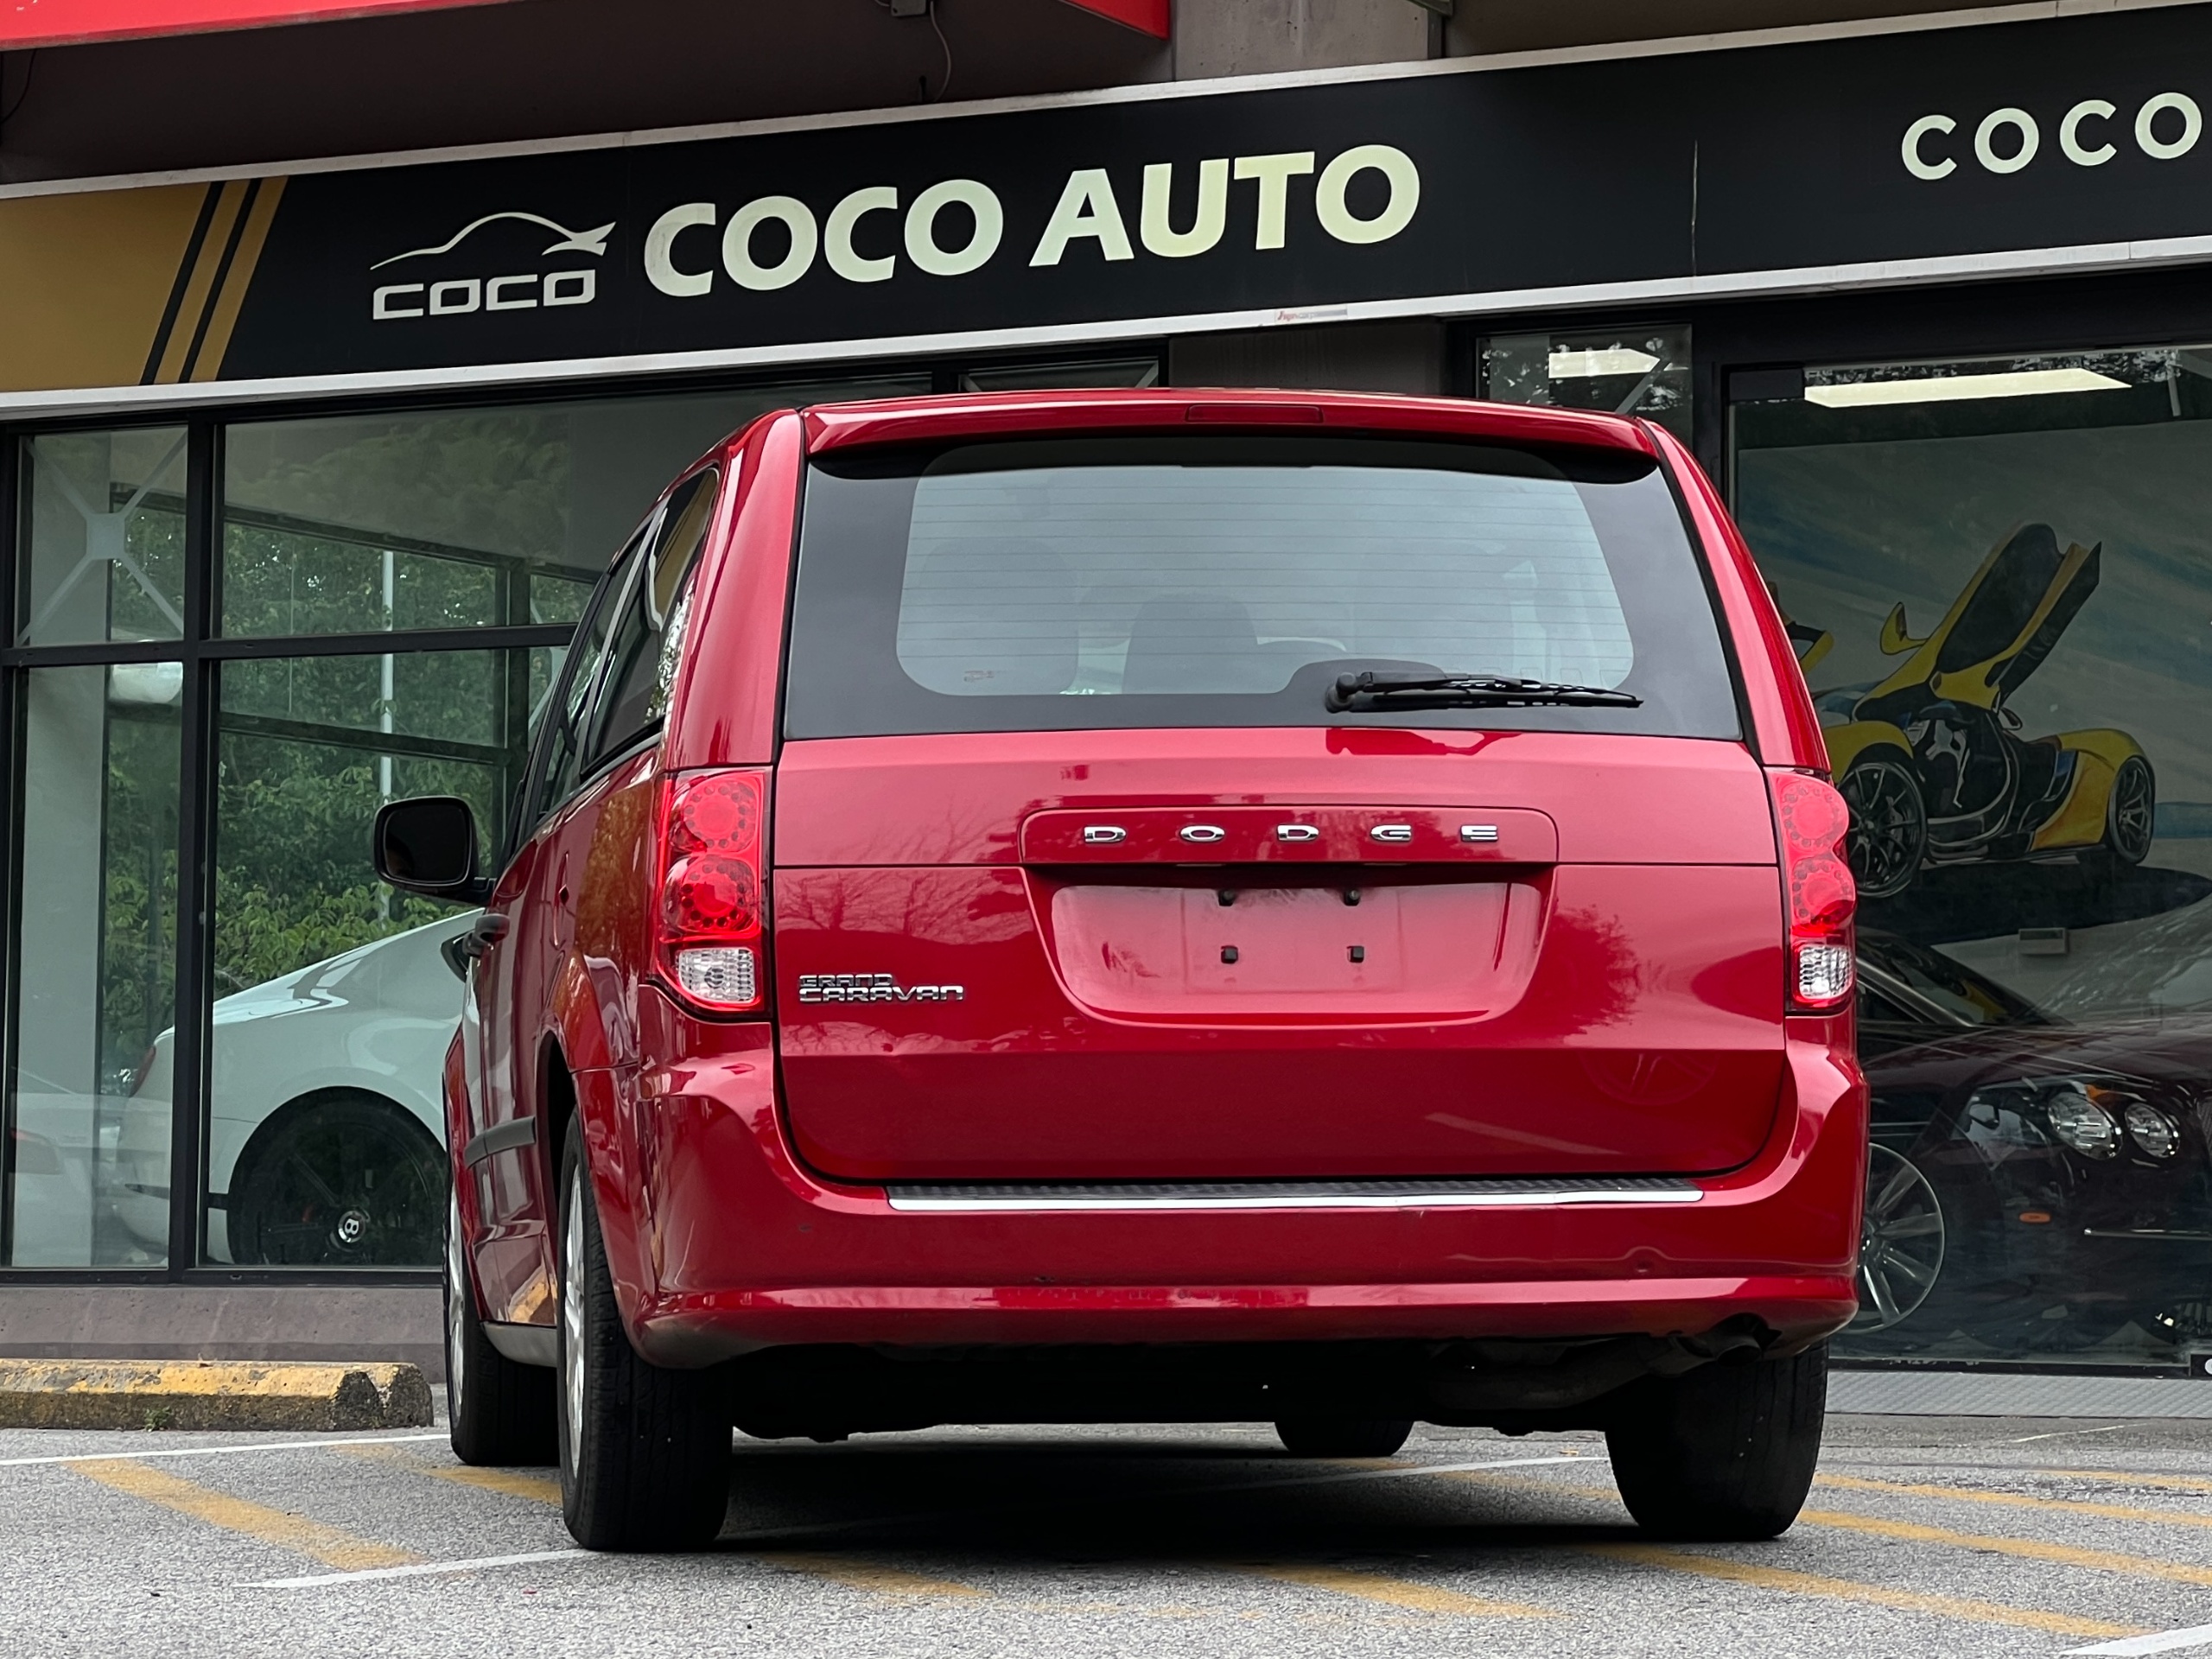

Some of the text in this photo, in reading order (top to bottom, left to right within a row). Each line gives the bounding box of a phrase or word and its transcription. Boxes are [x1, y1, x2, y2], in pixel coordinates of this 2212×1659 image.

[1901, 92, 2202, 181] COCO
[644, 144, 1421, 297] COCO AUTO
[372, 269, 596, 320] COCO
[1084, 823, 1499, 843] DODGE
[798, 973, 893, 988] GRAND
[798, 985, 964, 1002] CARAVAN
